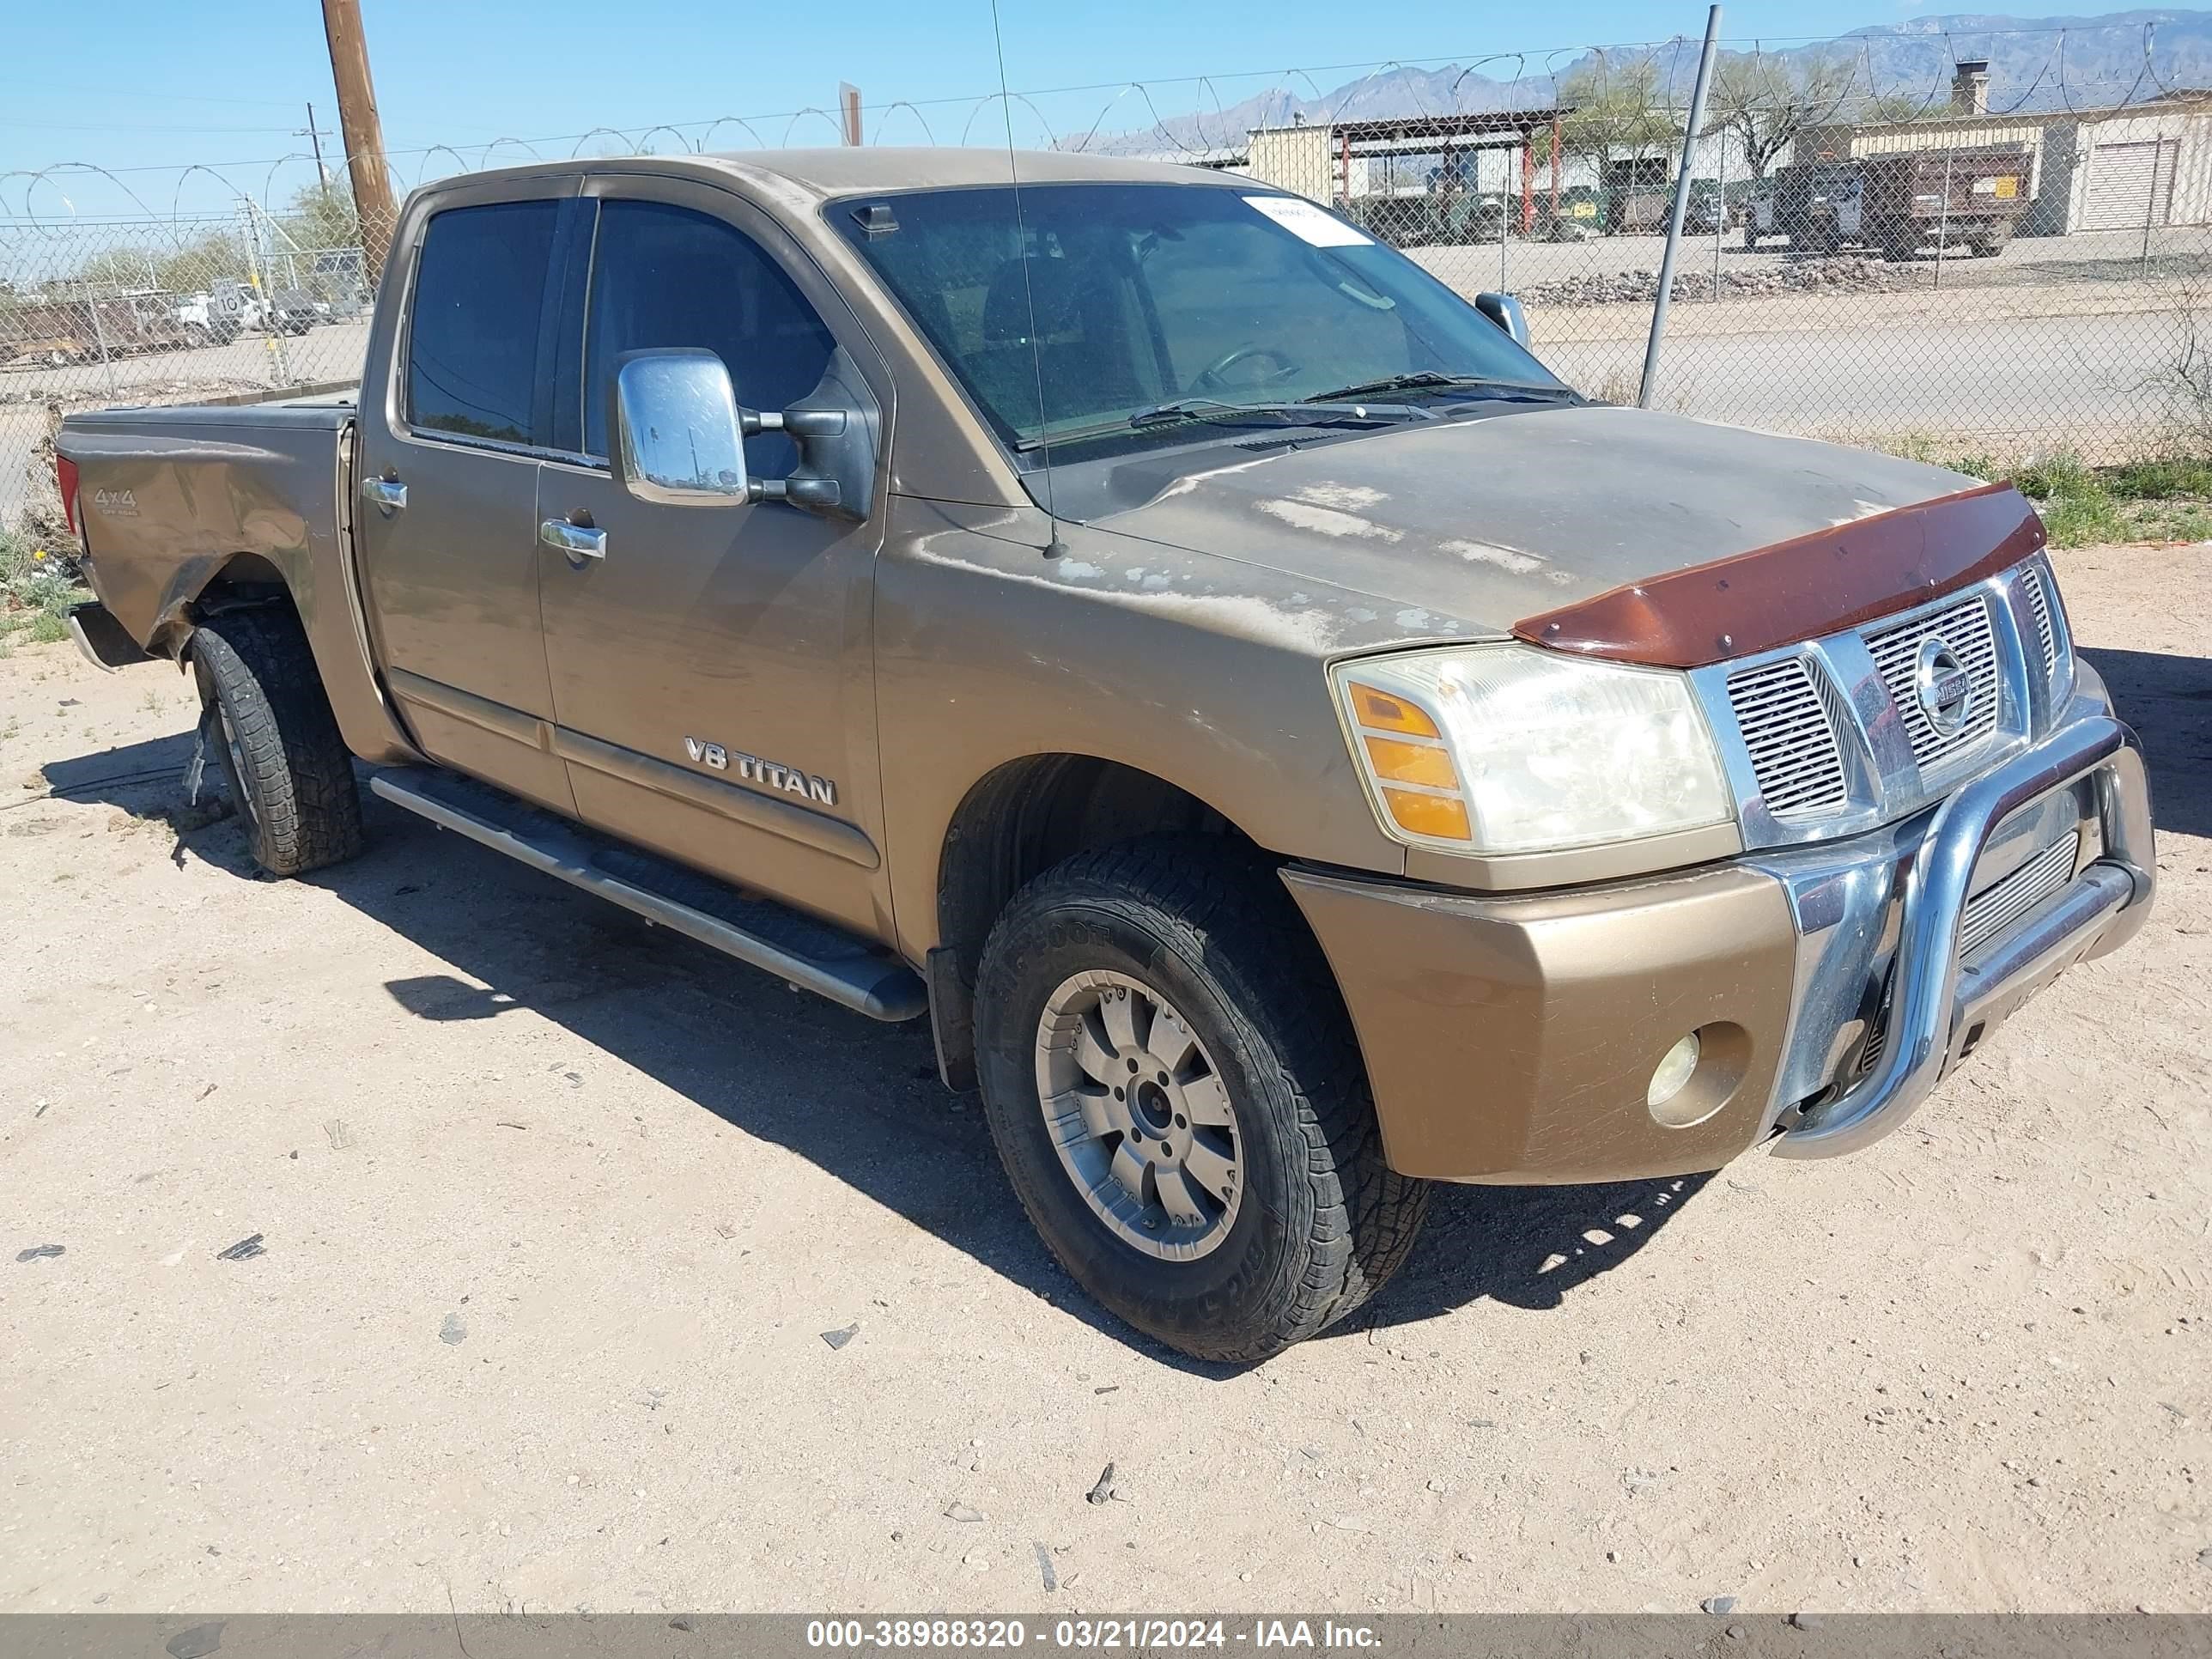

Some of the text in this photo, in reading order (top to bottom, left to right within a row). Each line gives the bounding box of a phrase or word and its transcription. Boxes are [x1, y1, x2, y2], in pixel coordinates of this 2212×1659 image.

[221, 297, 238, 312] 10
[684, 736, 838, 806] V8 TITAN
